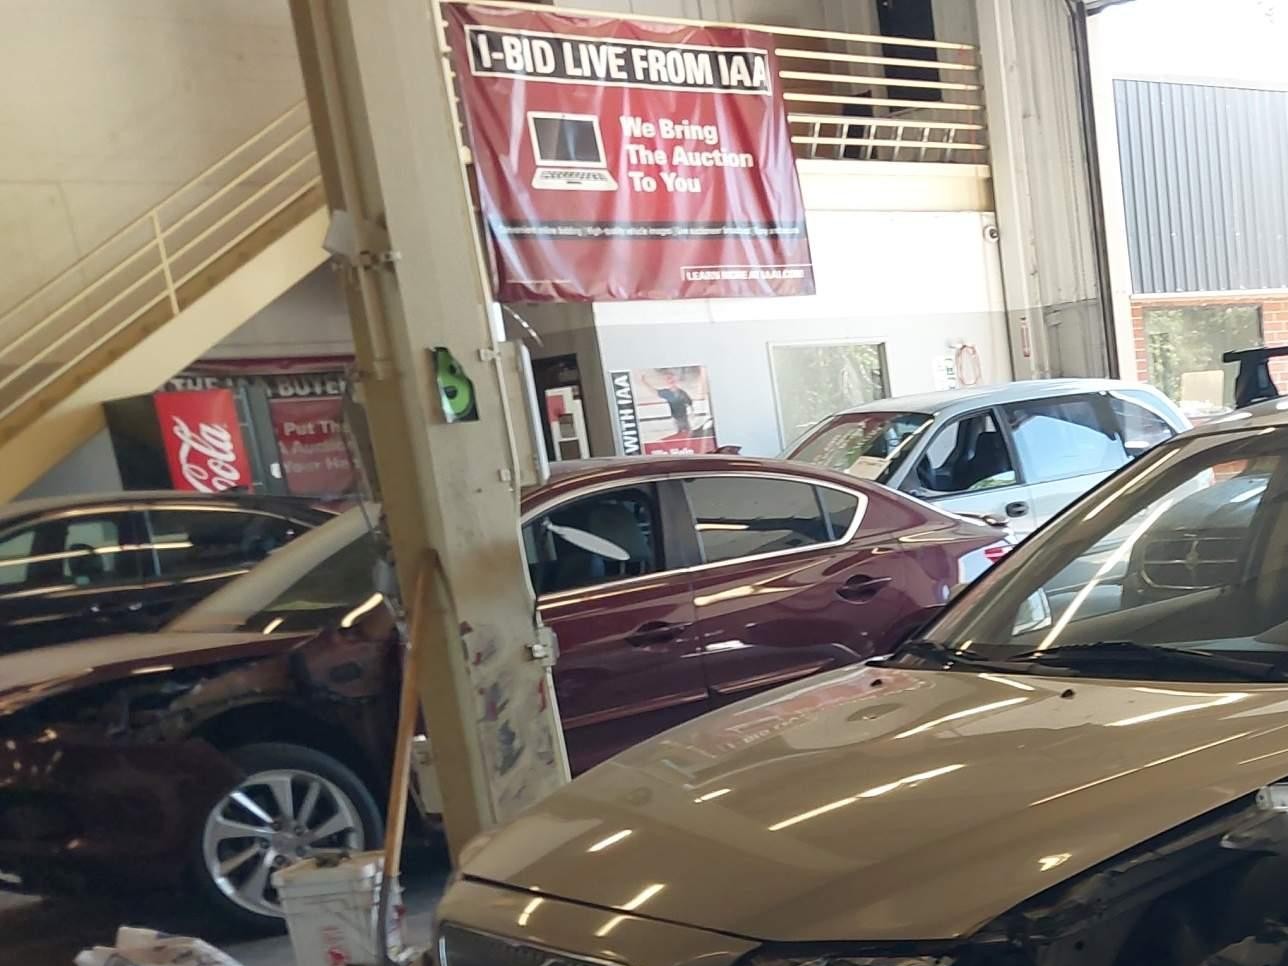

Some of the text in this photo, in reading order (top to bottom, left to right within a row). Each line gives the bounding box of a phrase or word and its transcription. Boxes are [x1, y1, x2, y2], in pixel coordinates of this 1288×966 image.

[477, 33, 768, 88] I-BID LIVE FROM IAA
[619, 115, 719, 145] We Bring
[625, 143, 754, 168] The Auction
[628, 171, 702, 193] To You
[614, 374, 639, 454] WITH IAA
